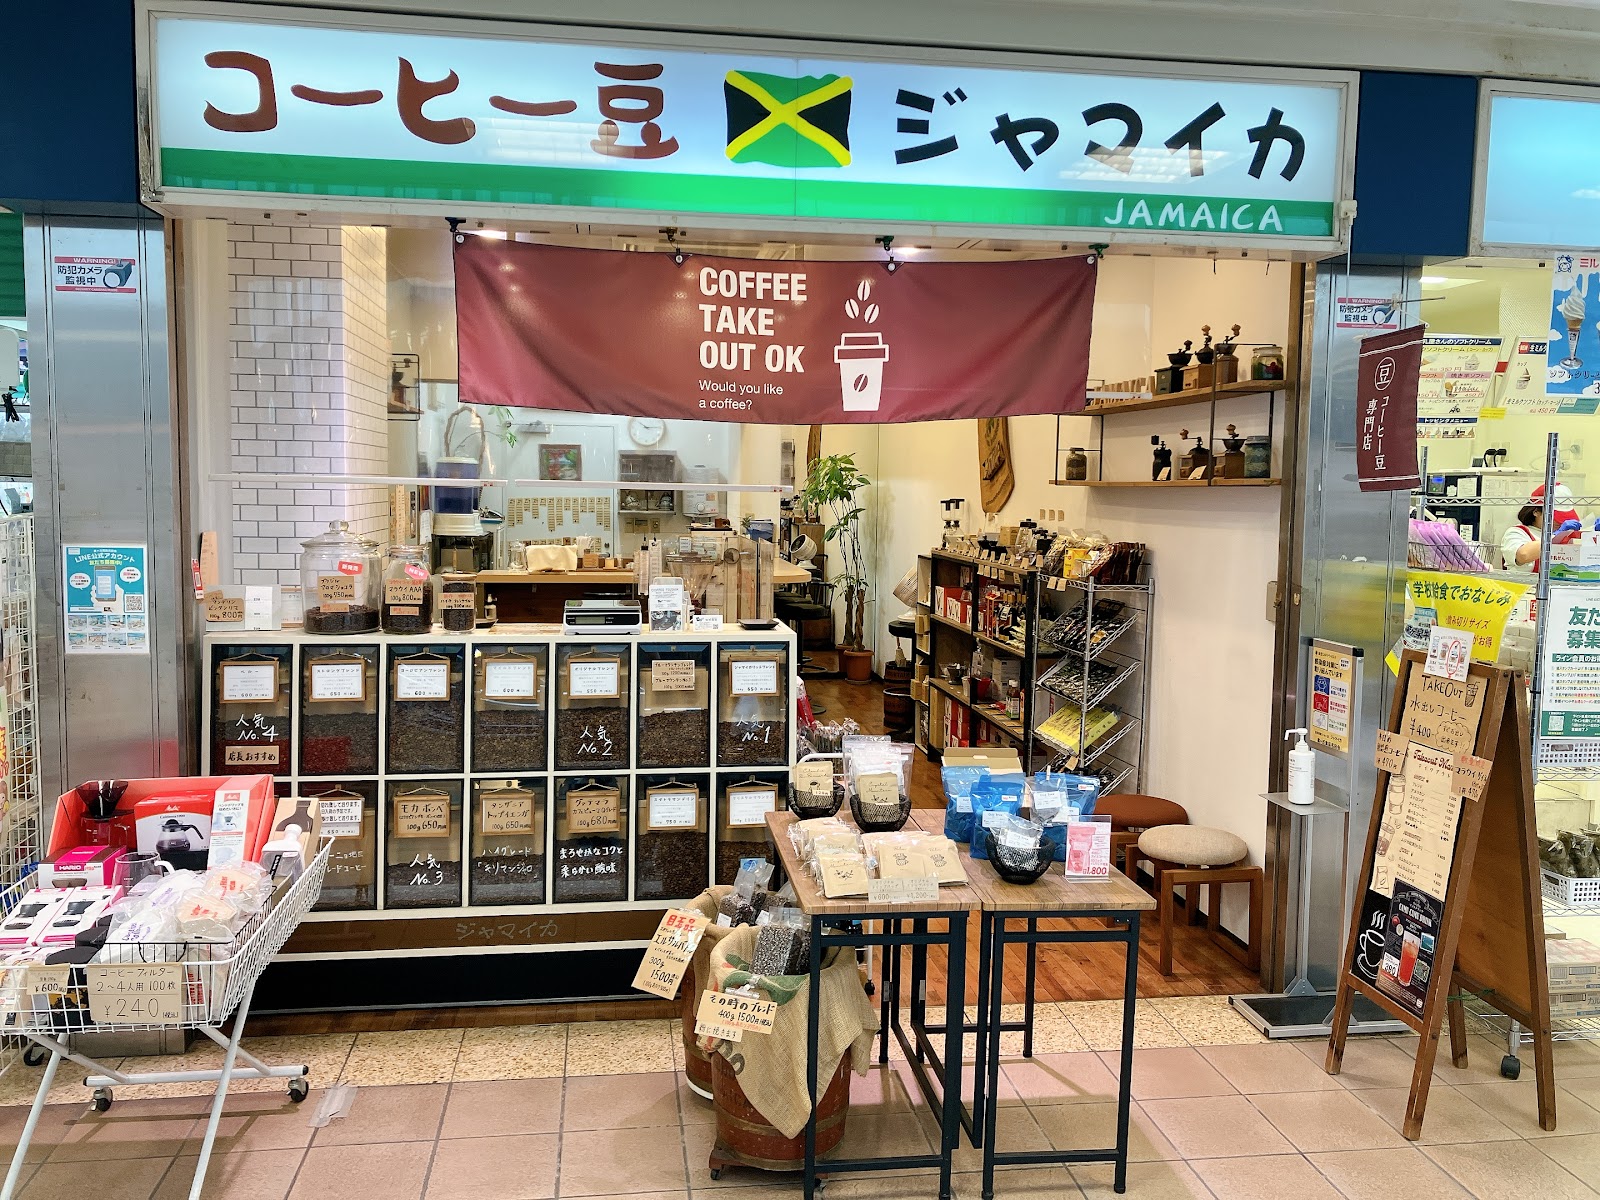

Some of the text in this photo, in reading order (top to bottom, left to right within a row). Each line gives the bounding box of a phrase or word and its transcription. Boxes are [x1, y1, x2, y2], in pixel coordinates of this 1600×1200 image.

[204, 51, 679, 159] コーヒー豆
[894, 87, 1306, 183] ジャマイカ
[1104, 198, 1283, 231] JAMAICA
[57, 265, 102, 275] 防犯カメラ
[65, 275, 96, 285] 監視中
[700, 267, 807, 301] COFFEE
[699, 304, 774, 336] TAKE
[1344, 314, 1368, 323] 監視中
[700, 340, 805, 373] OUT OK
[1377, 362, 1392, 385] 豆
[699, 380, 783, 396] Would you like
[699, 398, 752, 410] a coffee?
[1362, 398, 1378, 451] 専門店
[1374, 395, 1390, 471] コーヒー豆
[1413, 581, 1512, 606] 学校給食でおなじみ
[236, 713, 268, 730] 人気
[237, 725, 279, 742] No.4
[580, 724, 611, 742] 人気
[742, 726, 771, 744] No.1
[577, 741, 613, 755] No.2
[409, 853, 441, 869] 人気
[409, 870, 443, 885] No.3
[456, 919, 558, 941] ジャマイカ
